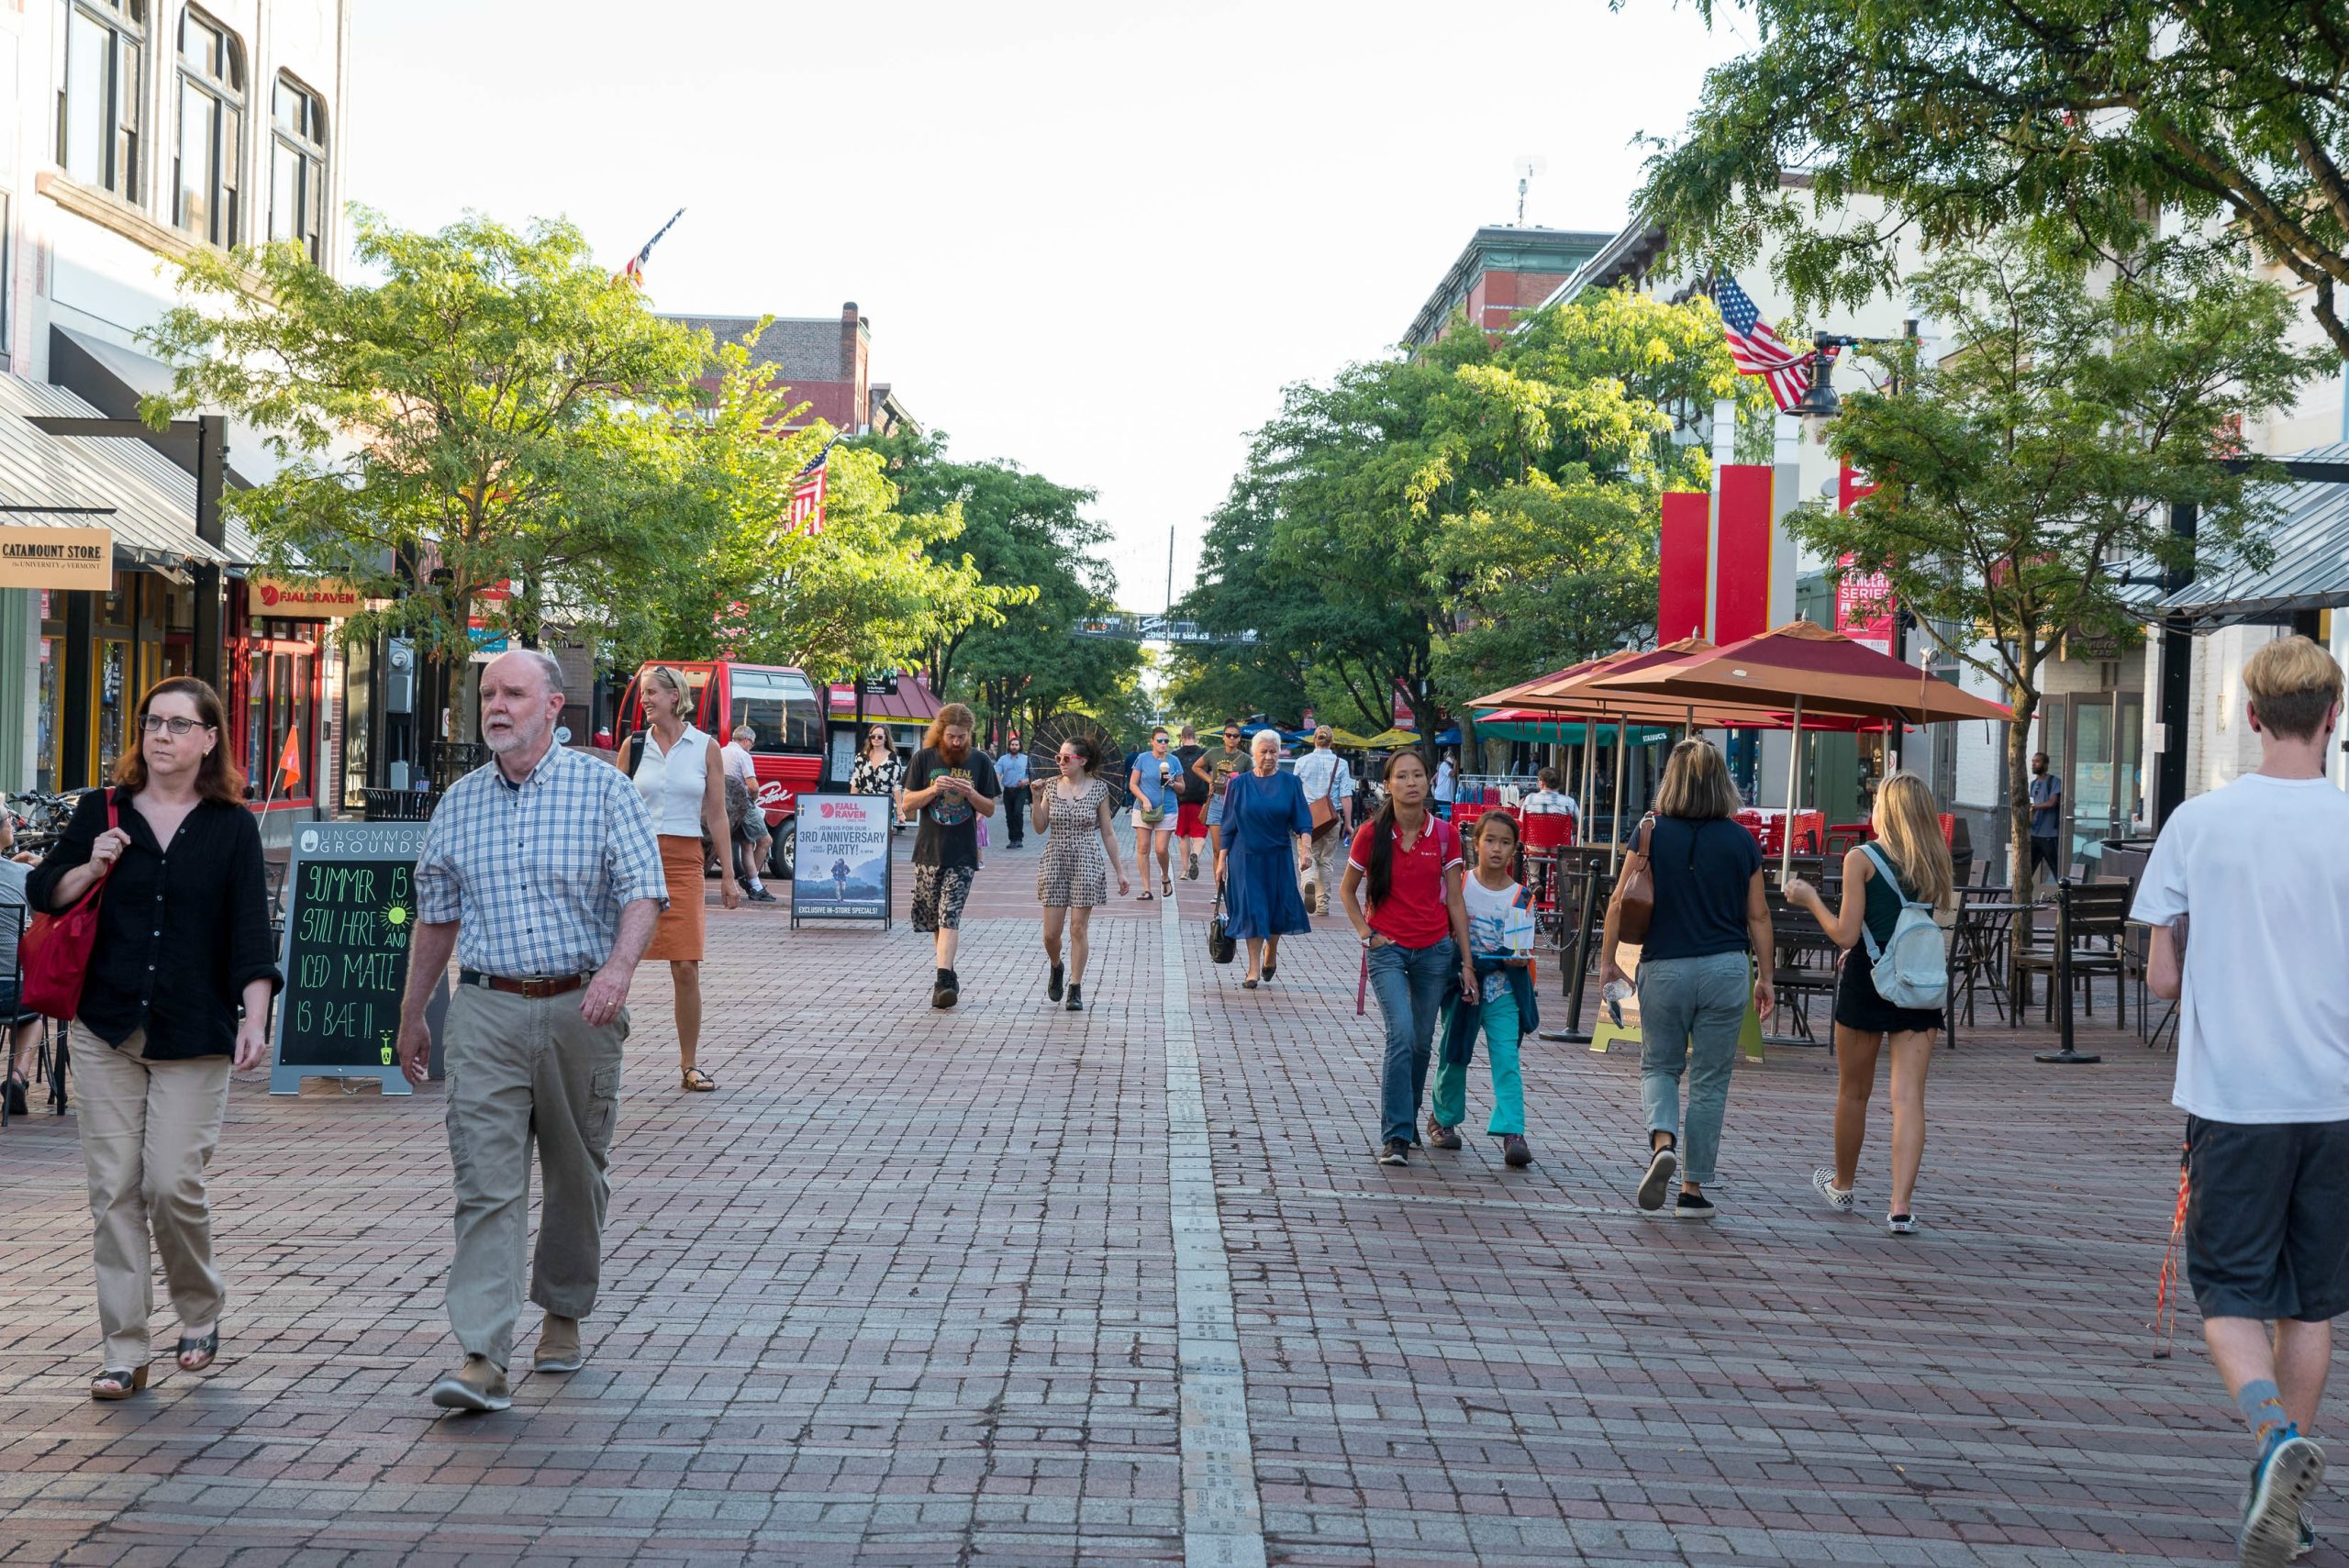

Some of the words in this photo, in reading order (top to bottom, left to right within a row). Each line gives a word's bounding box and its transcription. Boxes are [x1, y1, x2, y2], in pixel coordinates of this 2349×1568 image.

[3, 543, 64, 558] CATAMOUNT
[67, 545, 101, 559] STORE
[279, 591, 355, 604] FJALRAVEN
[1841, 587, 1891, 599] SERIES
[951, 767, 972, 779] REAL
[321, 829, 426, 841] UNCOMMON
[799, 831, 818, 842] 3RD
[820, 831, 885, 843] ANNIVERSARY
[319, 841, 424, 853] GROUNDS
[827, 844, 859, 855] PARTY!
[306, 865, 376, 903] SUMMER
[391, 866, 407, 899] IS
[827, 906, 852, 915] IN-STORE
[852, 906, 878, 915] SPECIALS!
[299, 907, 334, 941] STILL
[339, 910, 377, 947] HERE
[384, 931, 406, 949] AND
[300, 954, 330, 989] ICED
[342, 953, 402, 992] MATE
[297, 1000, 313, 1033] IS
[322, 1001, 358, 1039] BAE
